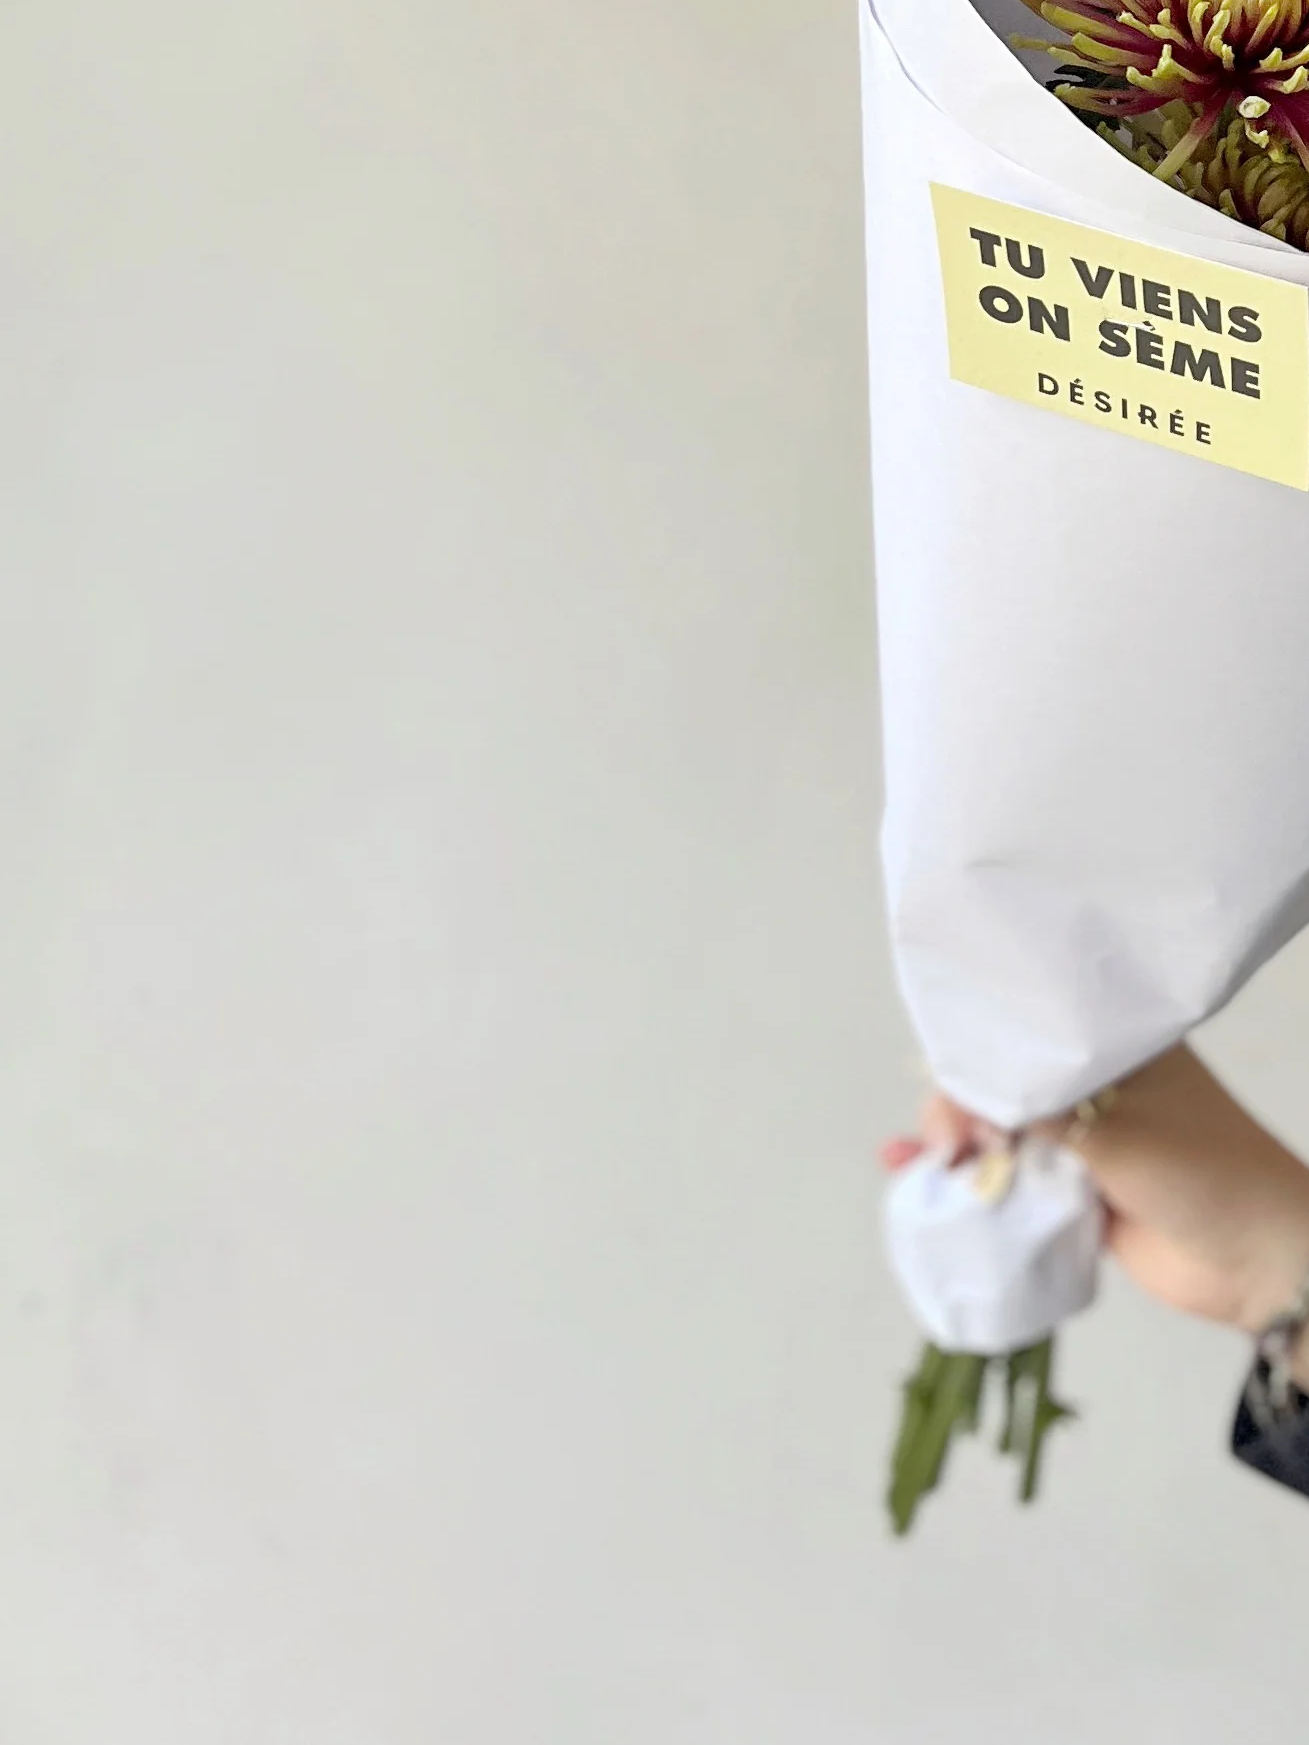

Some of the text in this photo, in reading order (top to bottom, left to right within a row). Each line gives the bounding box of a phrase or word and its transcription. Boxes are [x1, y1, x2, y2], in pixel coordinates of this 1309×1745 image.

[969, 226, 1263, 343] TU VIENS
[978, 285, 1262, 400] ON SÈME
[1037, 372, 1212, 445] DÉSIRÉE
